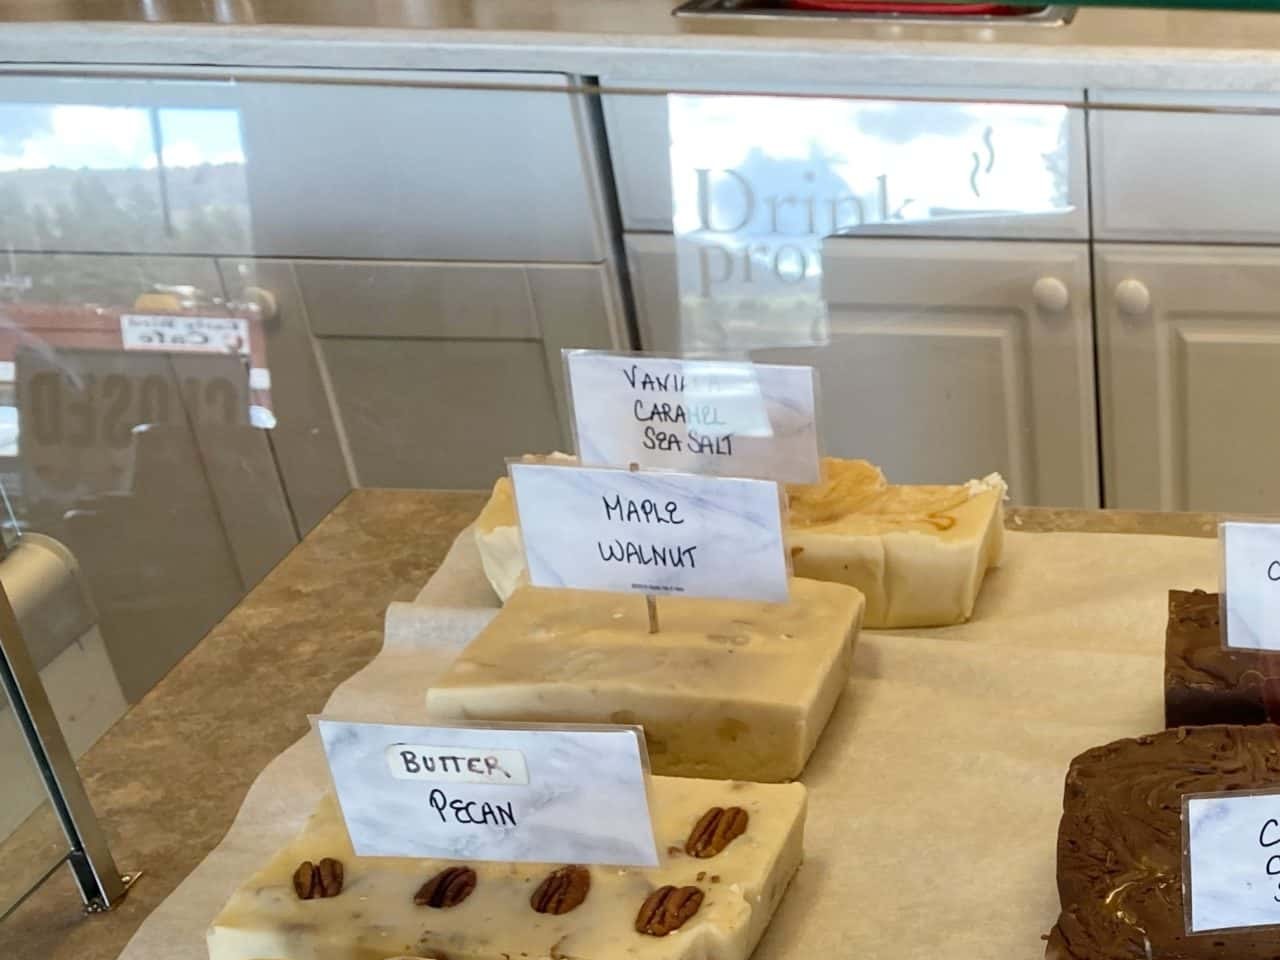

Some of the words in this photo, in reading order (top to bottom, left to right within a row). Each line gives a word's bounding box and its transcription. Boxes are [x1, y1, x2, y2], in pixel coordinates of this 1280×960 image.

[694, 168, 915, 236] Drink
[642, 425, 682, 452] SEA
[687, 433, 733, 457] SALT
[602, 494, 685, 525] MAPLE
[598, 540, 697, 569] WALNUT
[399, 750, 512, 779] BUTTER
[429, 788, 517, 827] PECAN
